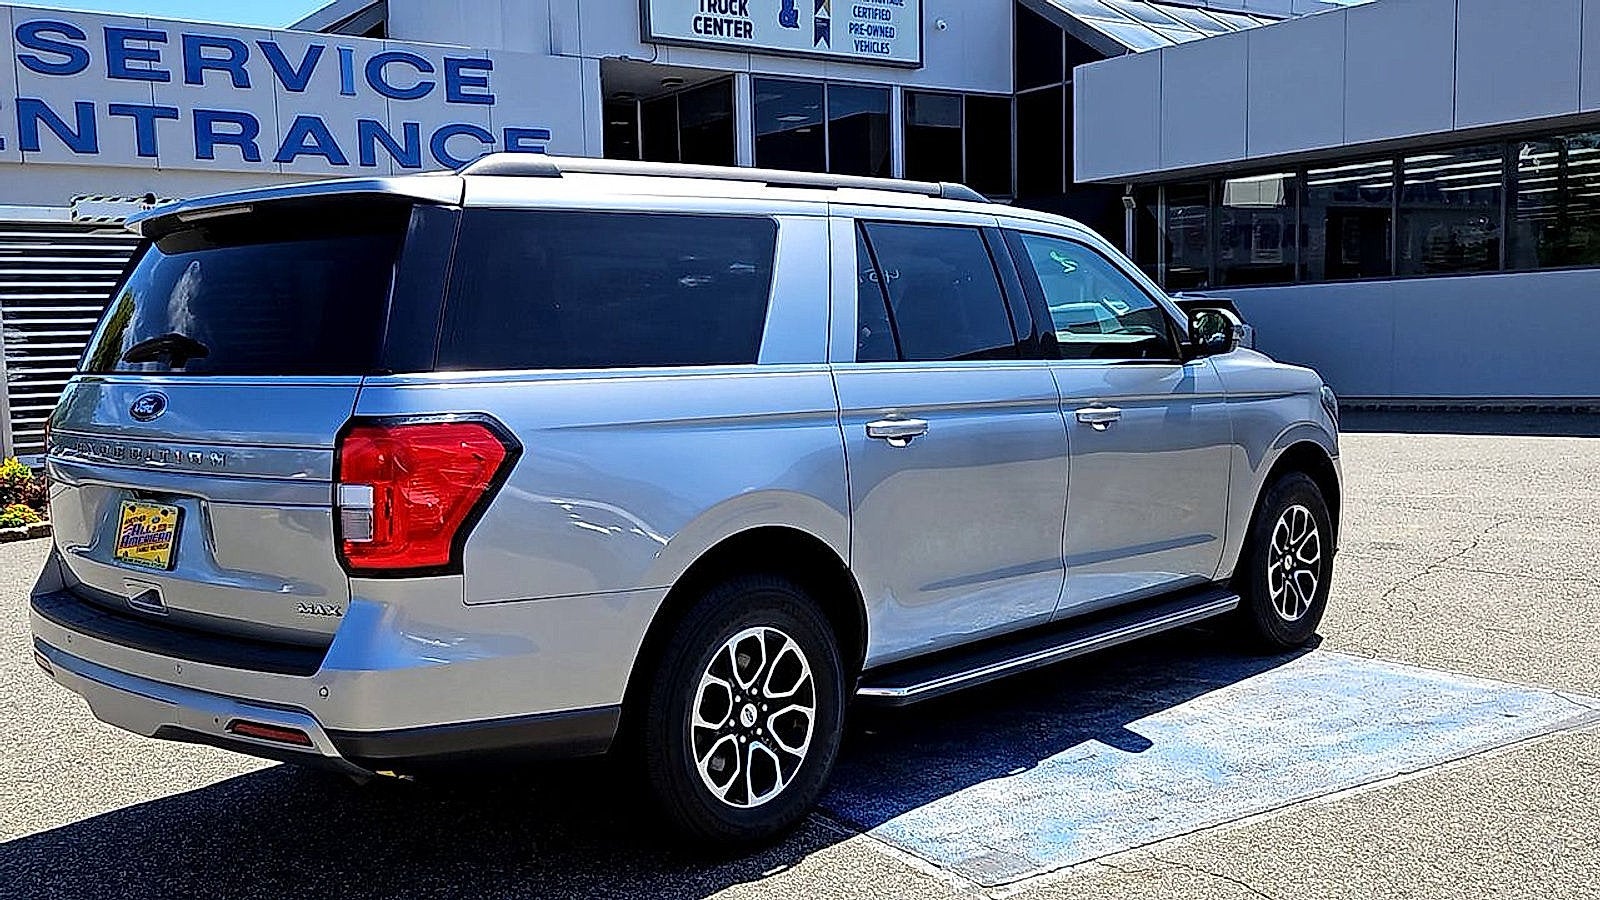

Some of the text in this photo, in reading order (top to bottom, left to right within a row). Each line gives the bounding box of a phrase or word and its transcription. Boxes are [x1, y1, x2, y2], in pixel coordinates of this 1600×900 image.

[700, 0, 748, 17] TRUCK
[853, 5, 891, 21] CERTIFIED
[693, 16, 753, 39] CENTER
[848, 22, 895, 38] PRE-OWNED
[853, 39, 890, 54] VEHICLES
[15, 20, 496, 105] SERVICE
[0, 97, 551, 171] NTRANCE
[296, 602, 343, 618] MAX
